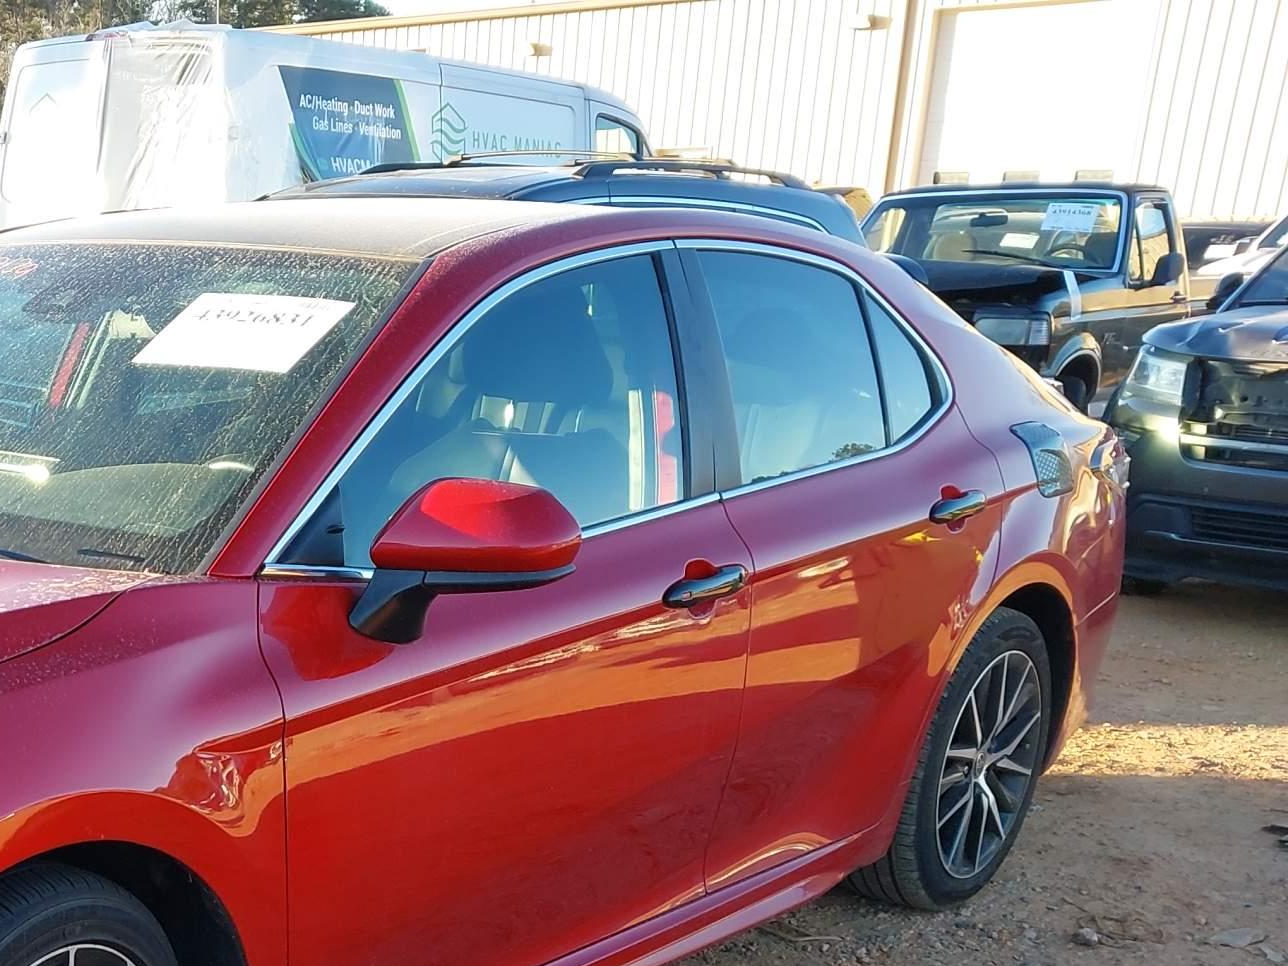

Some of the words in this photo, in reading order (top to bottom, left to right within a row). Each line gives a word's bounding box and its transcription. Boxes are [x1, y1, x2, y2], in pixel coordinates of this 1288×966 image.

[299, 94, 348, 114] AC/Heating
[354, 101, 373, 116] Duct
[374, 103, 395, 118] Work
[312, 117, 329, 131] Gas
[330, 118, 353, 133] Lines
[359, 122, 402, 140] Ventilation
[472, 130, 508, 151] HVAC
